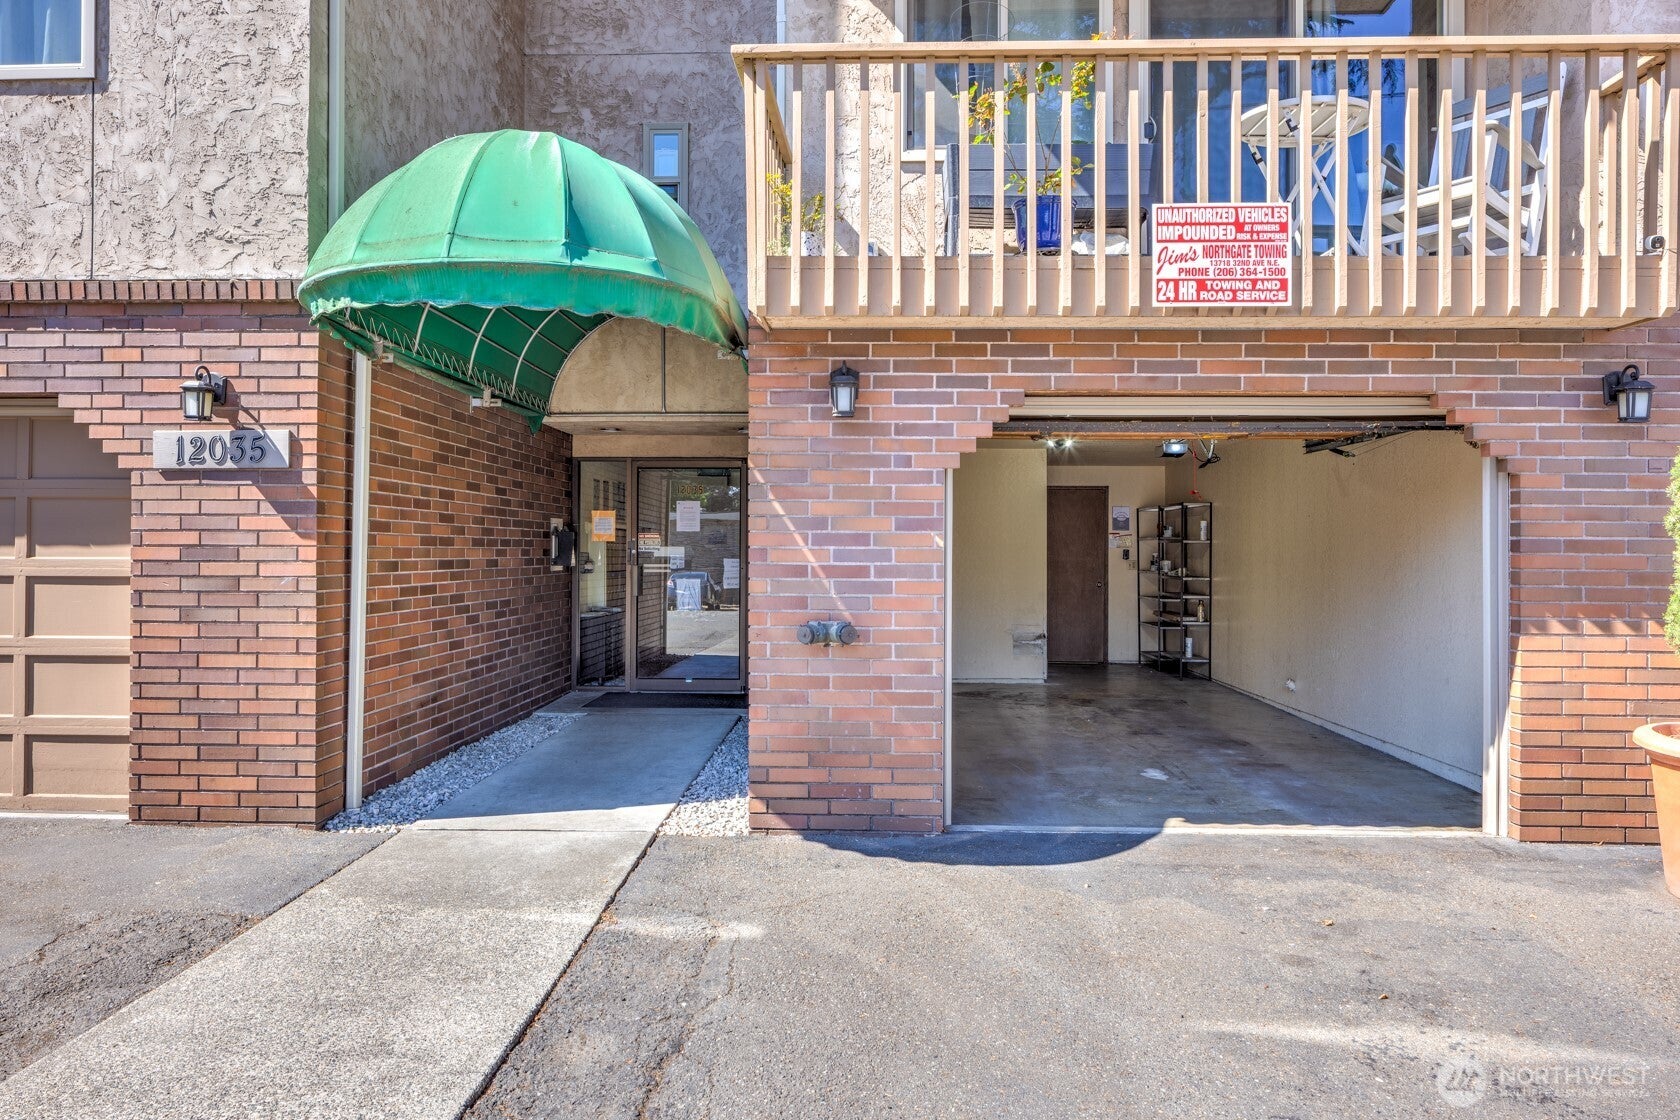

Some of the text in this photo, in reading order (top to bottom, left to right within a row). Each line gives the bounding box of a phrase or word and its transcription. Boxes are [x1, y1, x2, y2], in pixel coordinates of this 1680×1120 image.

[1157, 207, 1288, 223] UNAUTHORIZED VEHICLES
[1157, 225, 1236, 241] IMPOUNDED
[1244, 224, 1280, 232] AT OWNERS
[1236, 232, 1287, 240] RISK & EXPENSE
[1202, 244, 1288, 259] NORTHGATE TOWING
[1156, 246, 1199, 276] Jim's
[1210, 259, 1280, 267] 13718 32ND AVE N.E.
[1178, 267, 1287, 278] PHONE (206) 364-1500
[1157, 280, 1198, 301] 24 HR
[1204, 280, 1281, 290] TOWING AND
[1199, 290, 1287, 301] ROAD SERVICE
[175, 434, 267, 465] 12035
